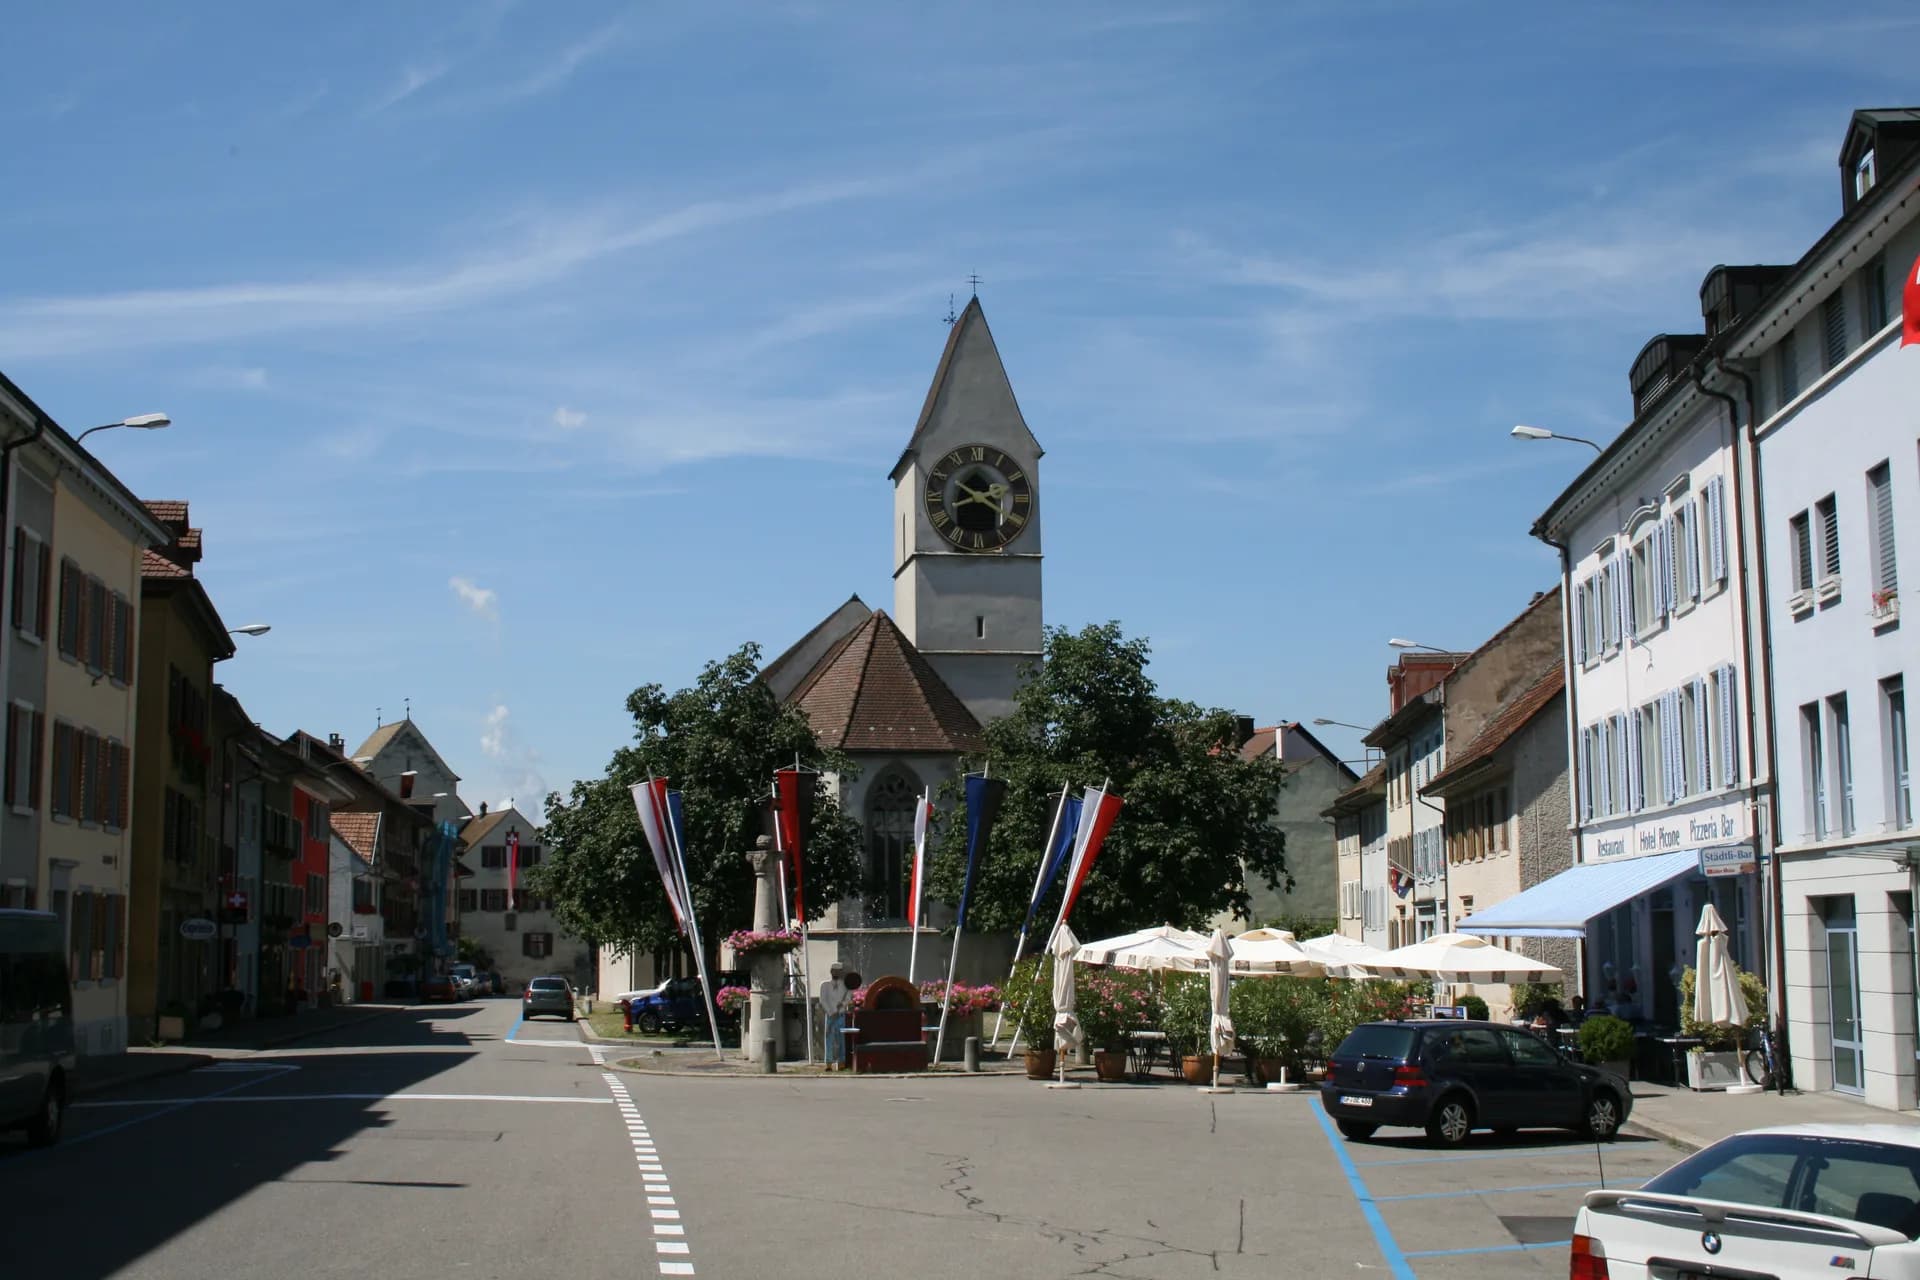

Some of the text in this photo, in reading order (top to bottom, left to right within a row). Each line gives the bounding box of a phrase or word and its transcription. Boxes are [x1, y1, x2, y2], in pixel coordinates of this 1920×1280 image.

[971, 447, 984, 461] XII
[1598, 814, 1734, 856] Restaurant Hotel Picone Pizzeria Bar
[1704, 850, 1753, 862] Städtli-Bar
